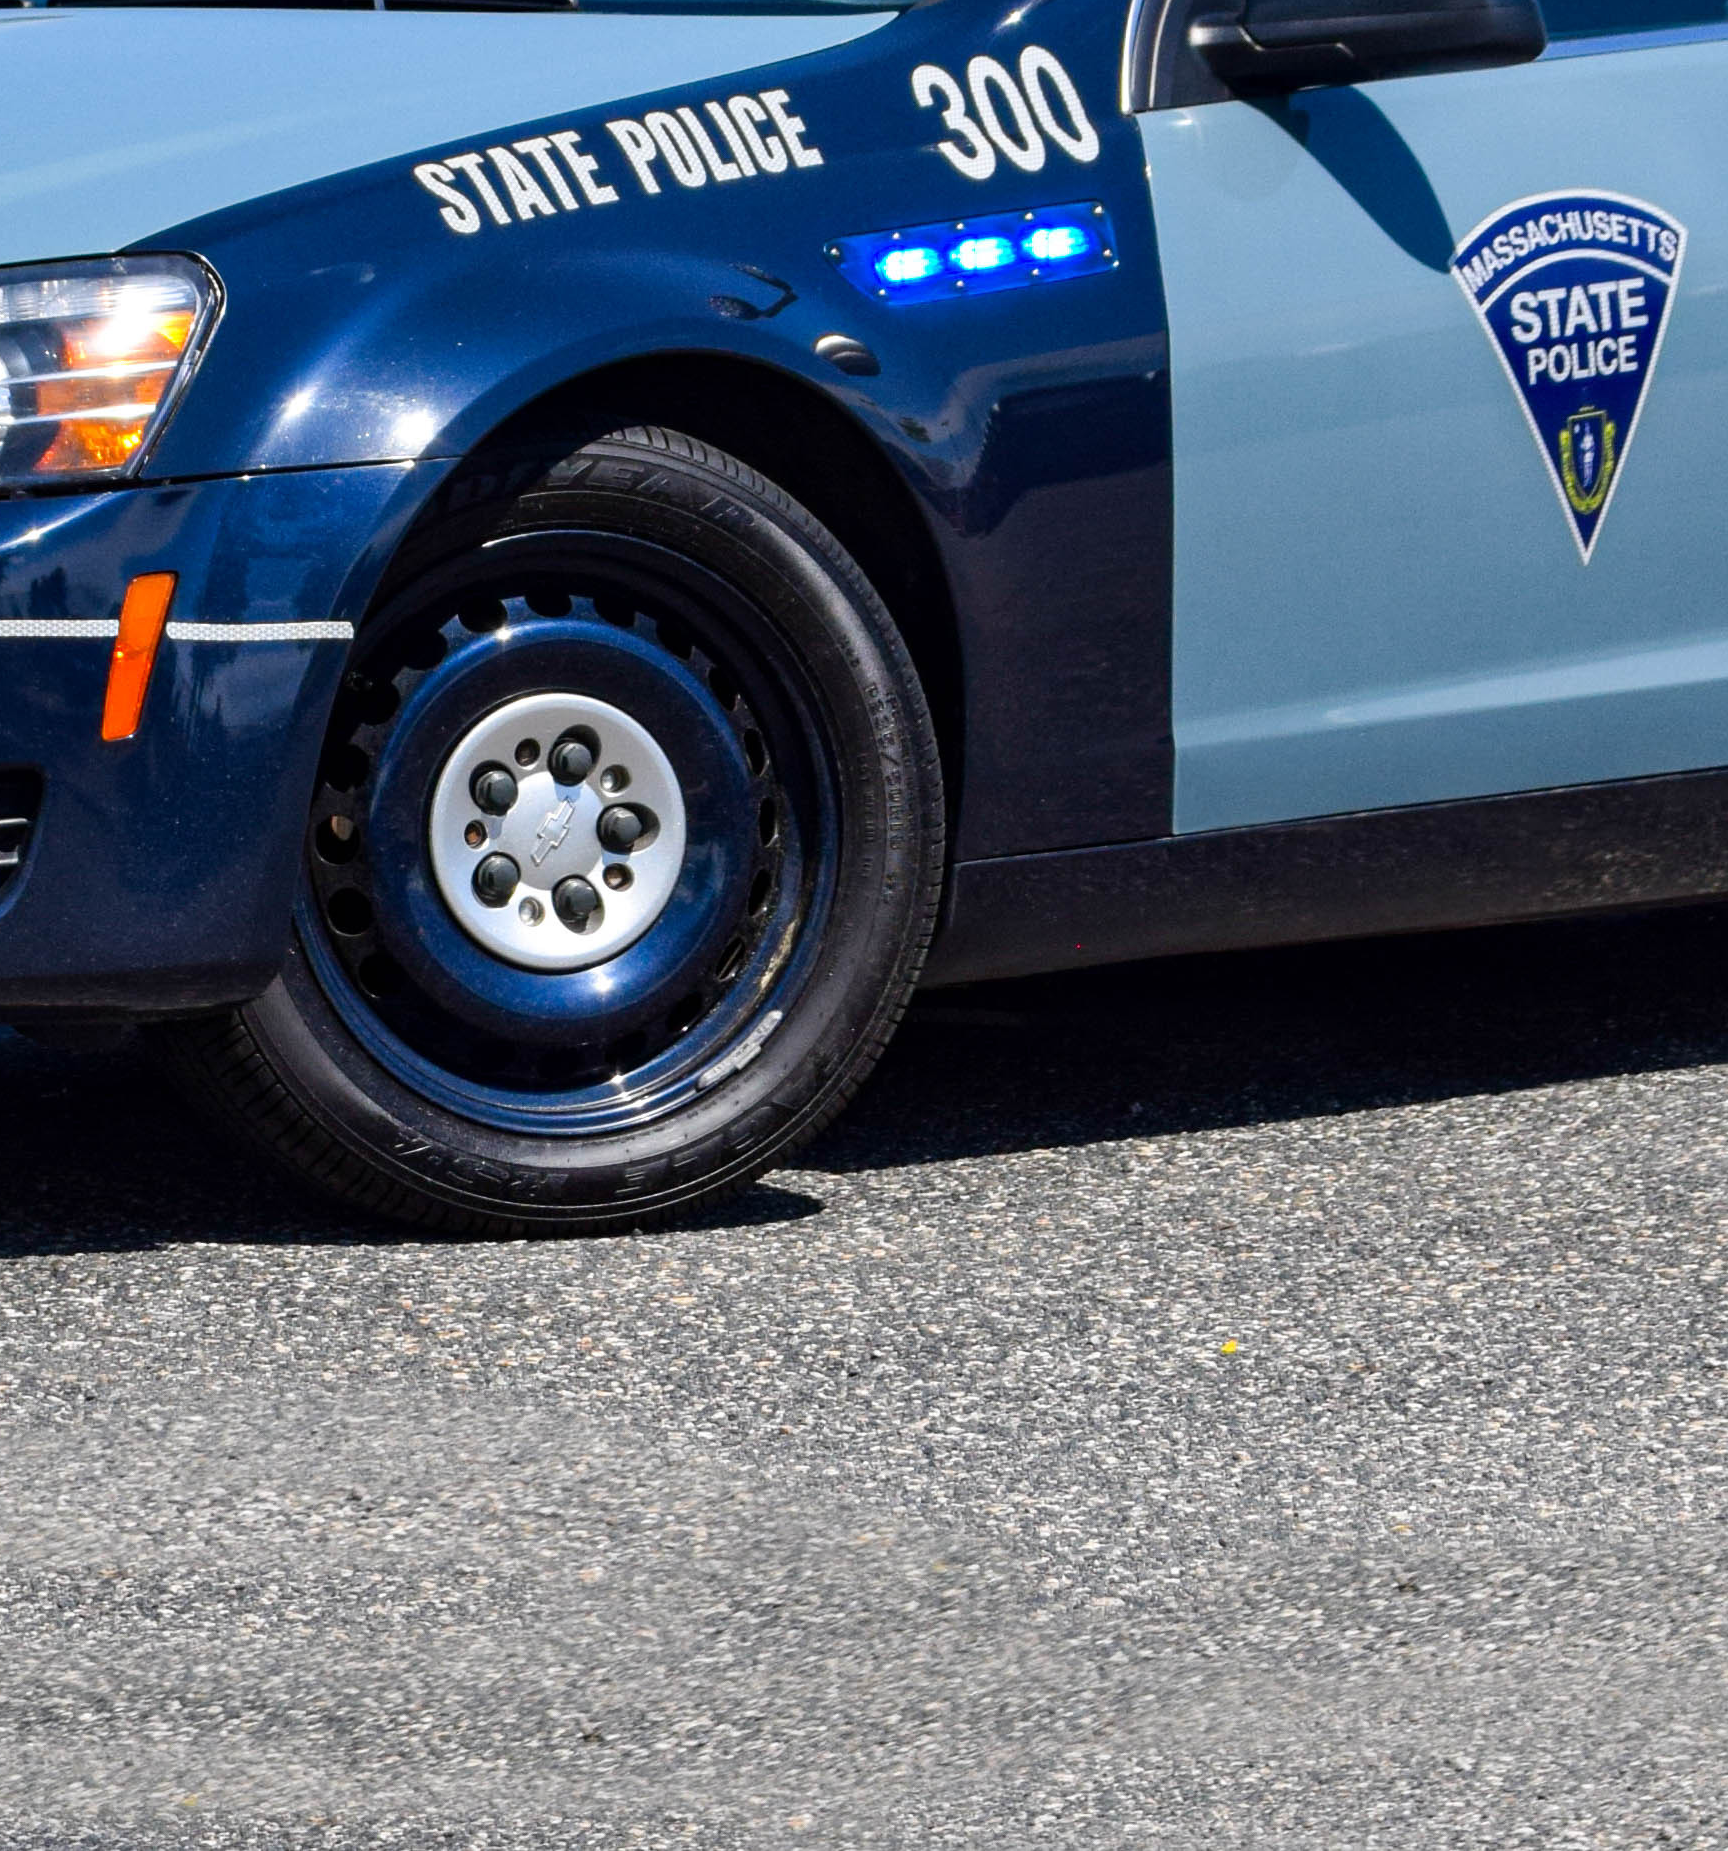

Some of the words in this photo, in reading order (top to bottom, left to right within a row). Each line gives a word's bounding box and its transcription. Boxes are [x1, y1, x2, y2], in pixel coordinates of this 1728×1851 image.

[911, 45, 1099, 180] 300
[413, 131, 618, 235] STATE
[604, 88, 824, 195] POLICE
[1460, 210, 1679, 293] MASSACHUSETTS
[1509, 277, 1650, 343] STATE
[1527, 335, 1639, 386] POLICE
